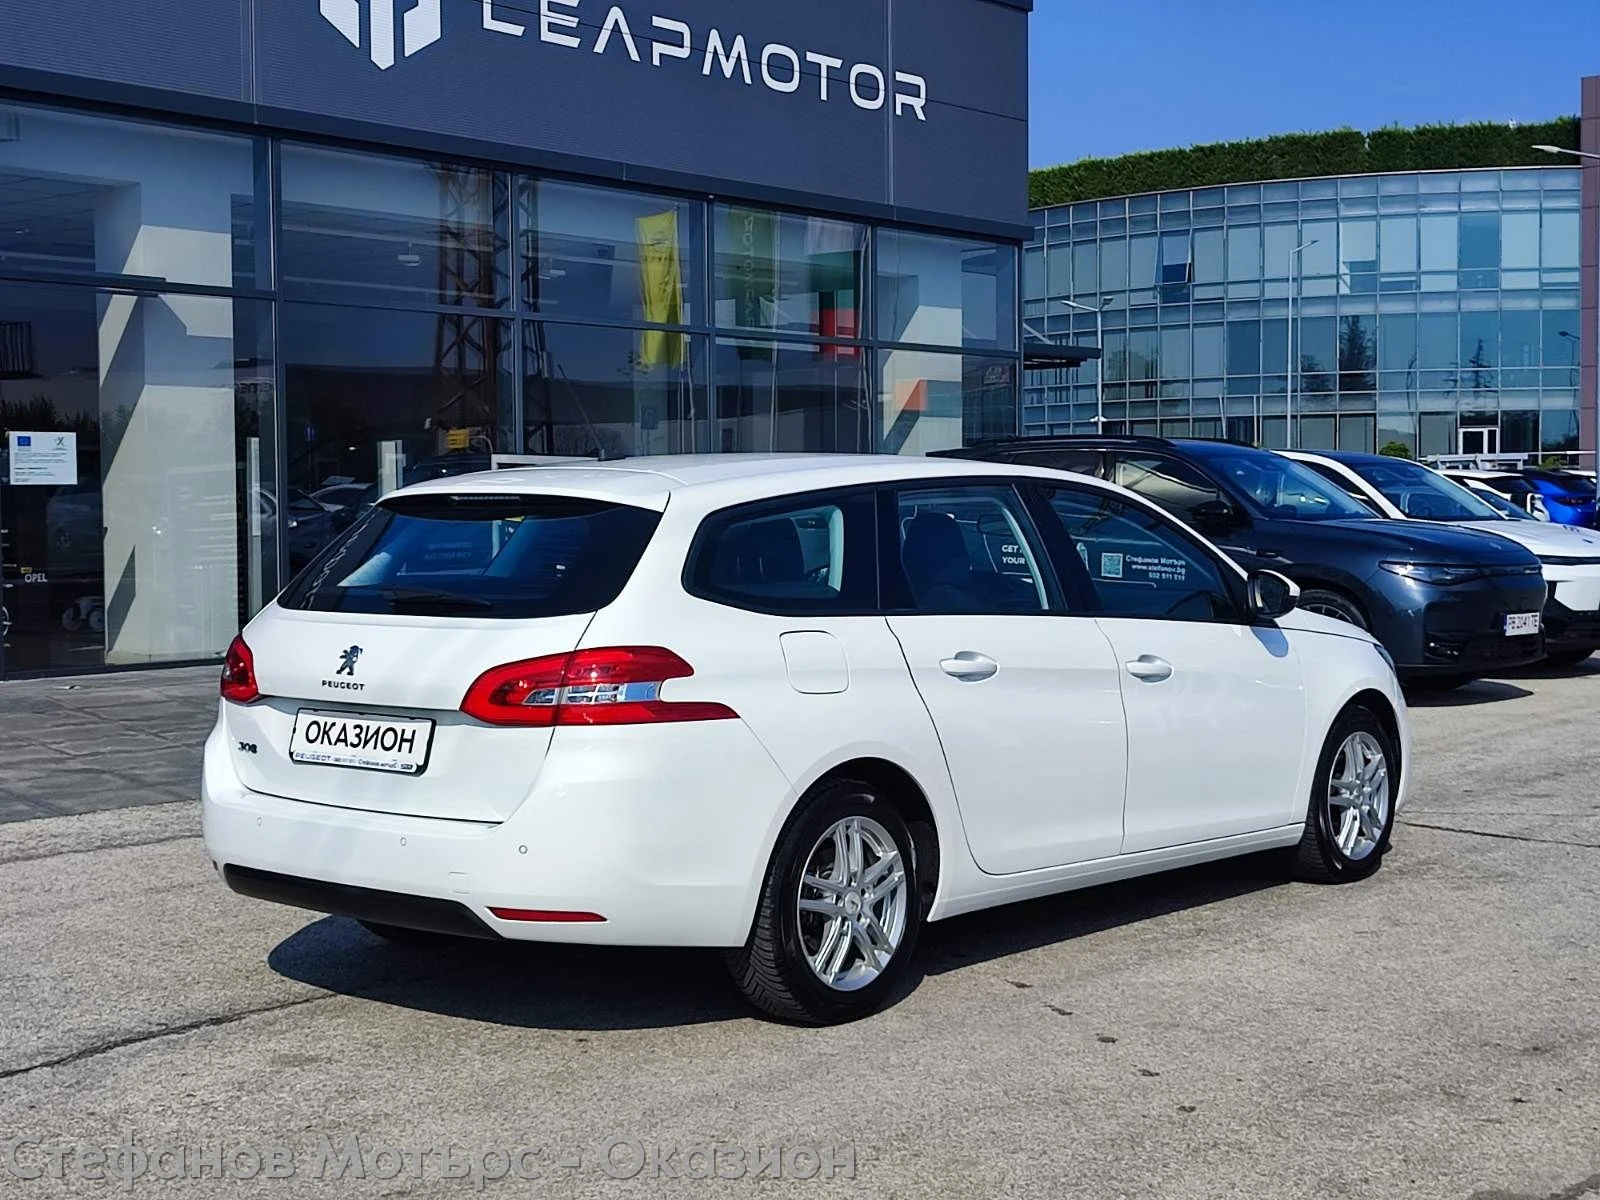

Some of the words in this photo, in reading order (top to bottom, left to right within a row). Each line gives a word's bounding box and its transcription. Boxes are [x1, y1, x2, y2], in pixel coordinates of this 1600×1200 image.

[482, 0, 927, 121] LEAPMOTOR
[1001, 544, 1018, 553] GET
[1001, 556, 1026, 565] YOUR
[24, 572, 48, 583] OPEL
[322, 680, 365, 690] PEUGEOT
[305, 720, 417, 754] ОКАЗИОН
[238, 740, 258, 754] 308
[294, 752, 332, 761] PEUGEOT
